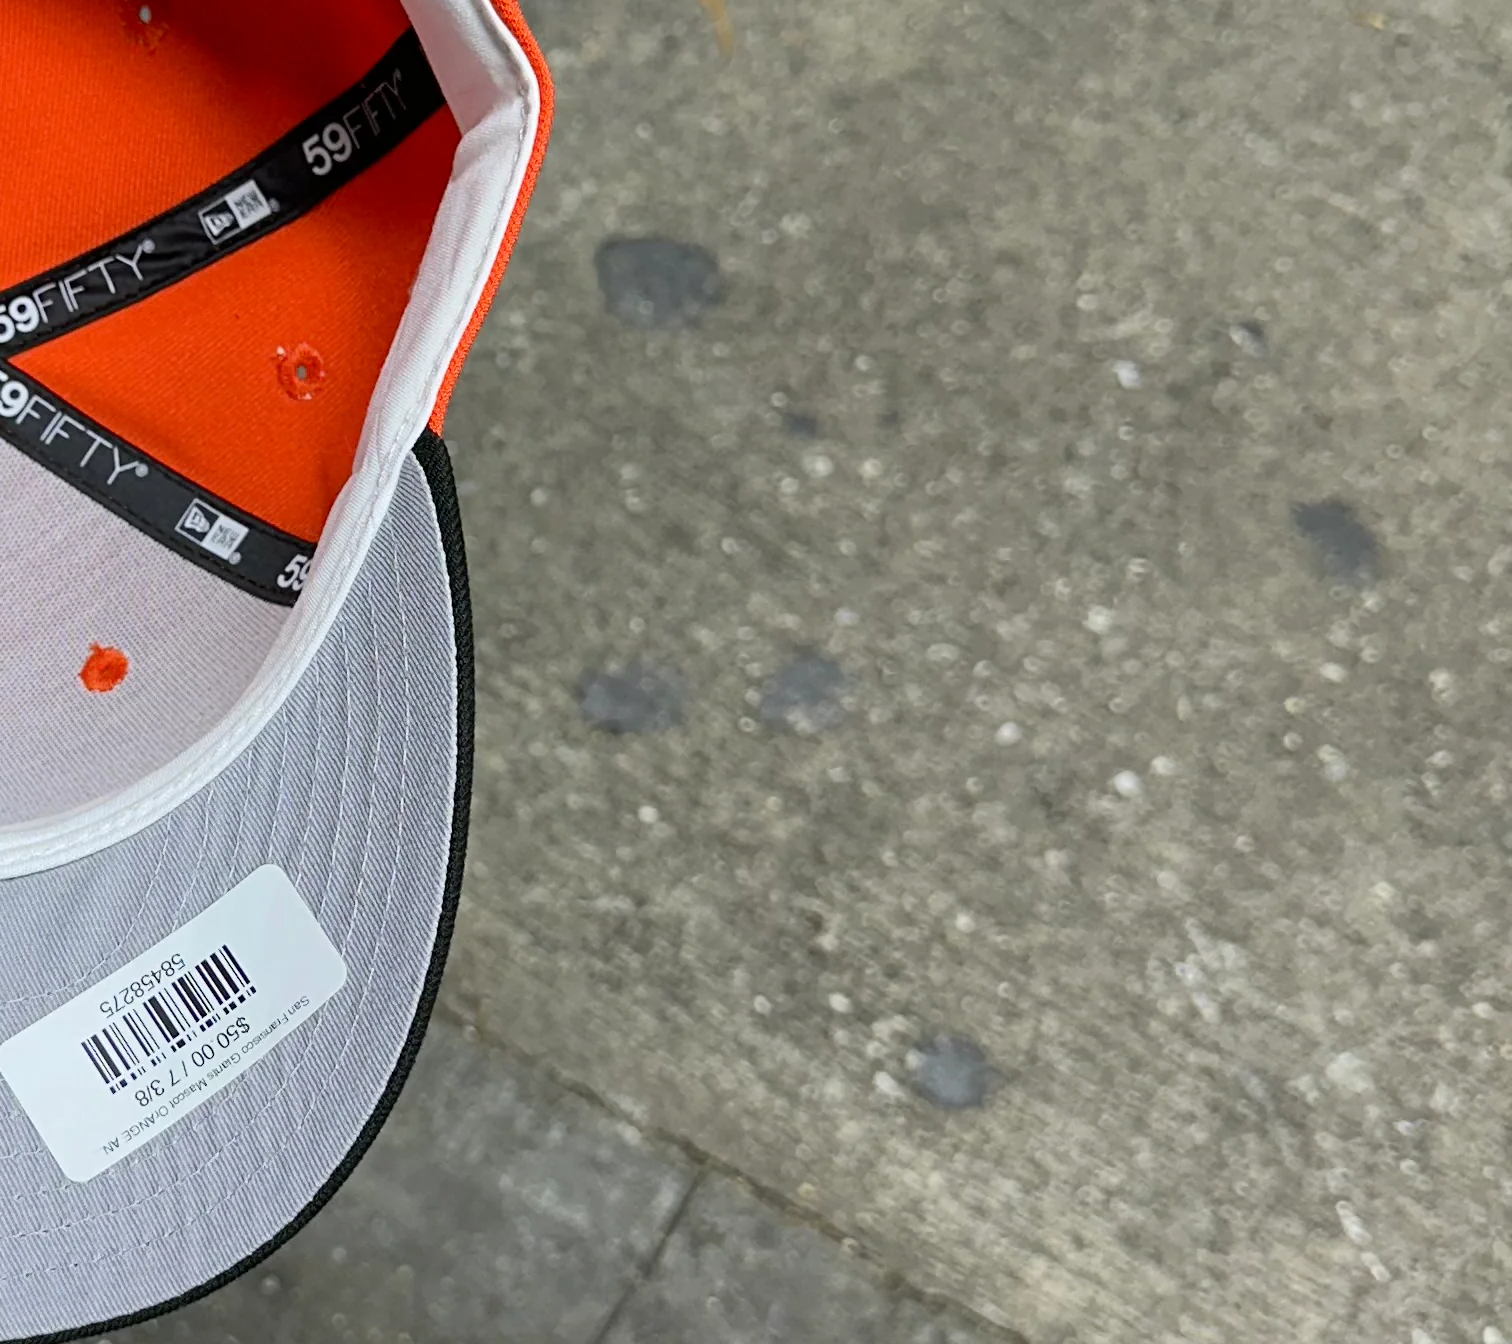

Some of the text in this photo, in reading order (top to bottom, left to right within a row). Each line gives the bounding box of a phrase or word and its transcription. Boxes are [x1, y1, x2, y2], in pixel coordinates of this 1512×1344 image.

[99, 953, 186, 1019] 58458275
[287, 995, 310, 1016] San
[191, 1016, 250, 1068] $50.00
[169, 1069, 181, 1087] 7
[206, 1052, 241, 1081] Giants
[134, 1079, 165, 1107] 3/8
[168, 1078, 208, 1108] Mascot
